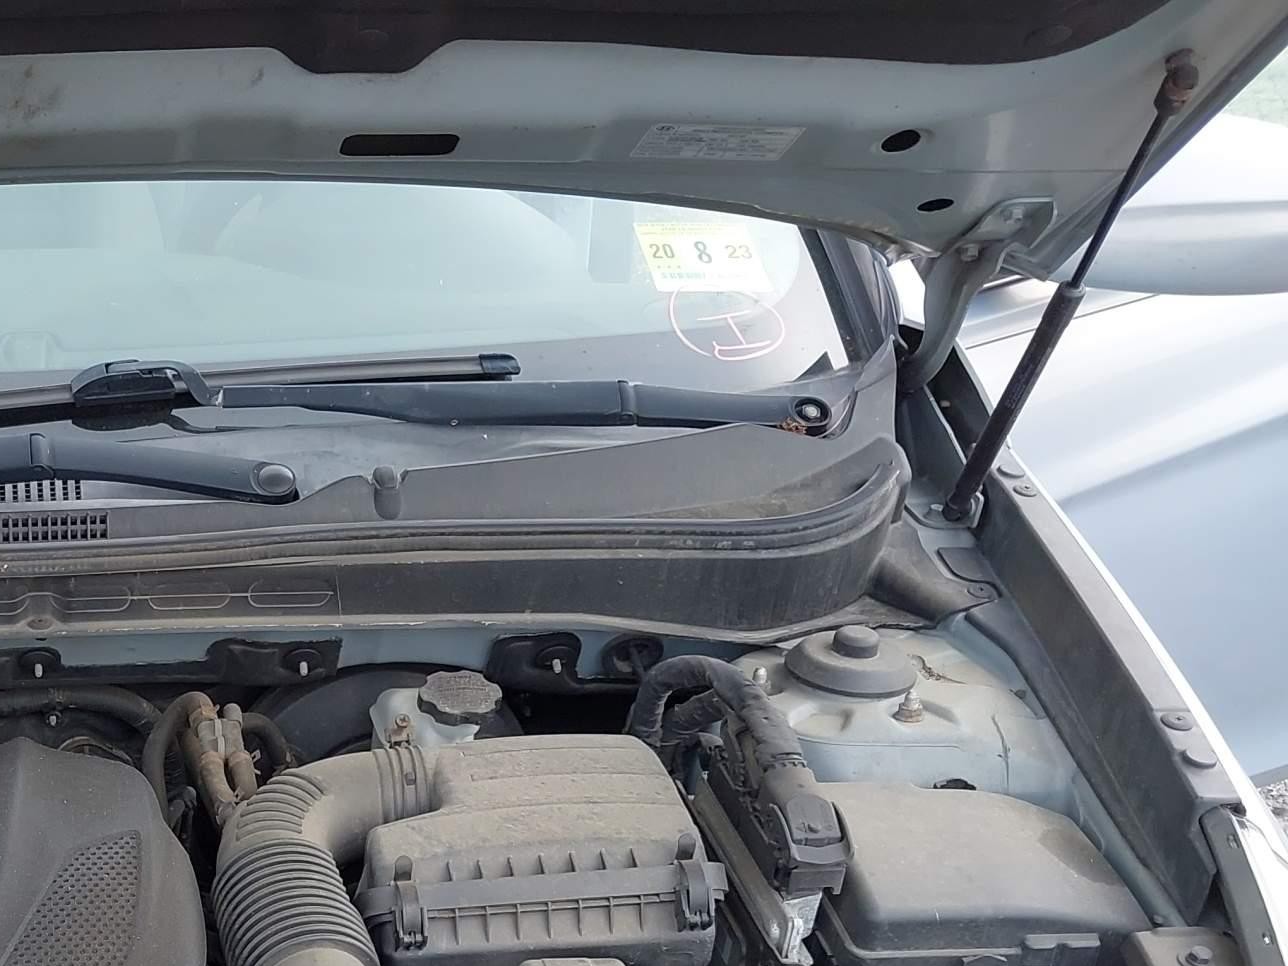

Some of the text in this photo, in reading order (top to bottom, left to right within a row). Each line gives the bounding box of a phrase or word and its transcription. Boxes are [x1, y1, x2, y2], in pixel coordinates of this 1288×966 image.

[648, 241, 753, 264] 20 8 23
